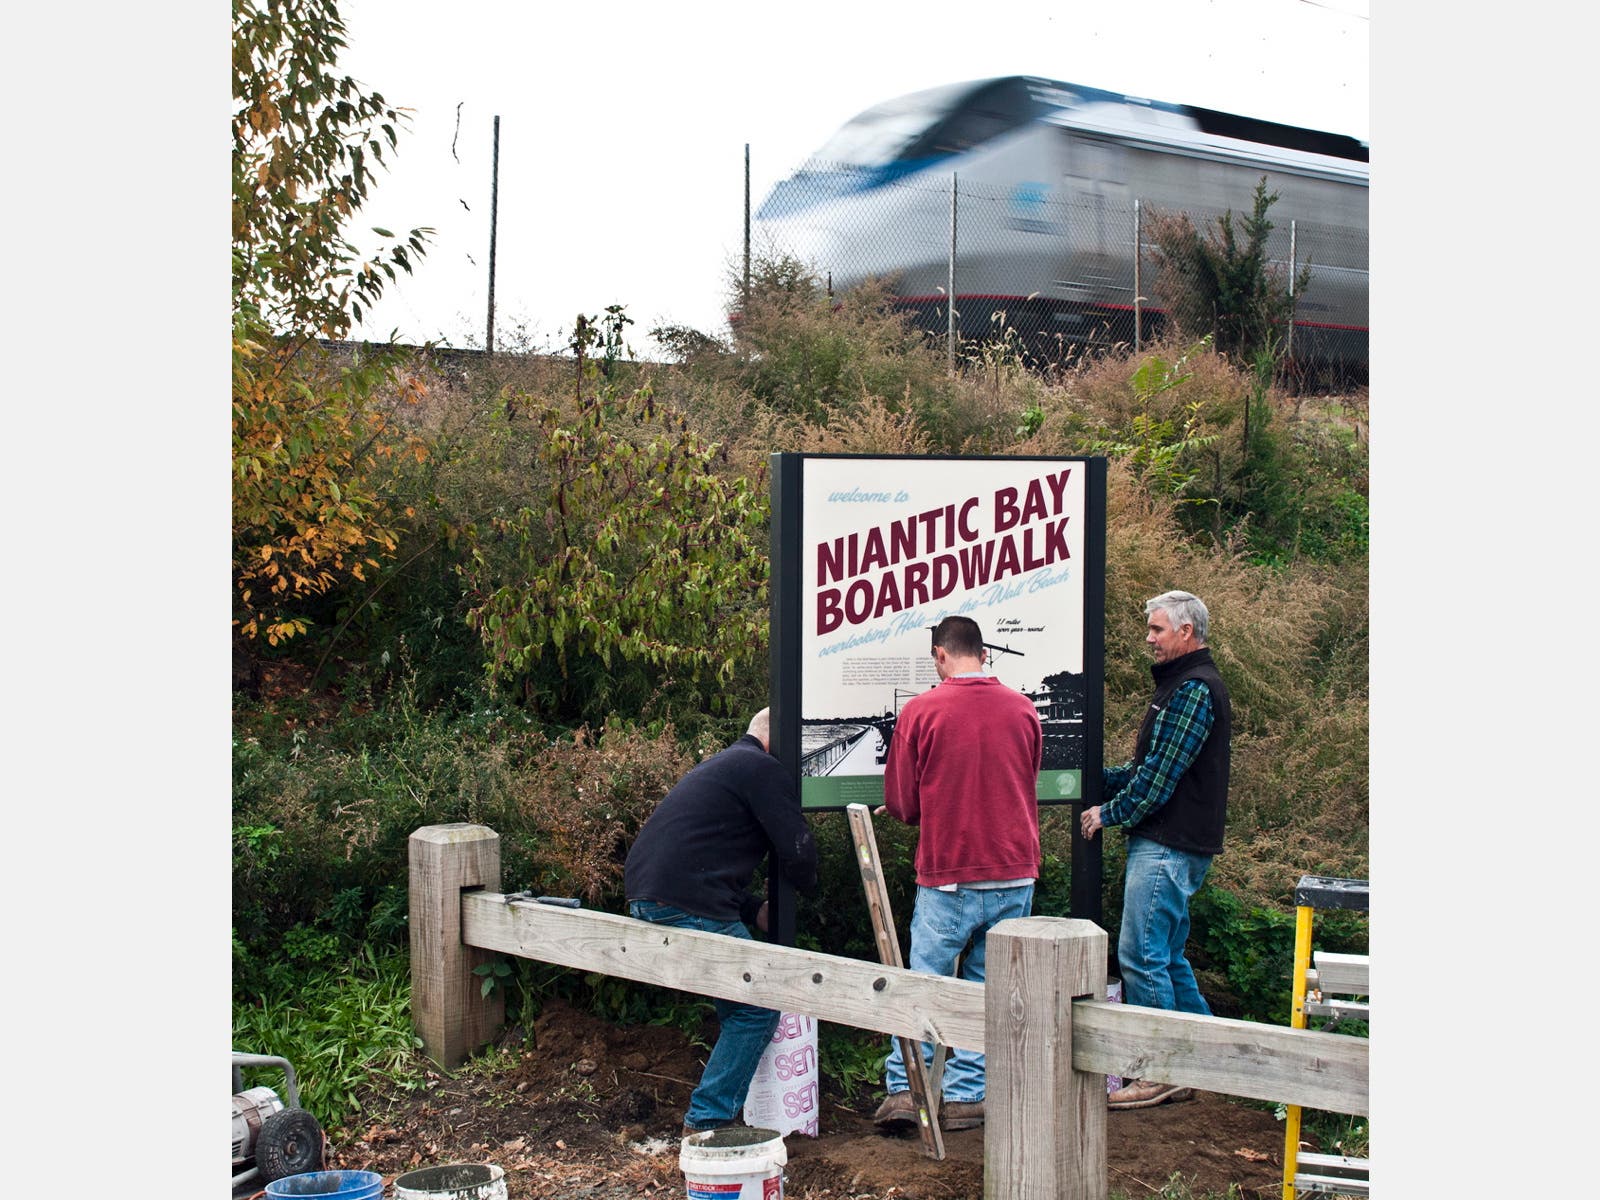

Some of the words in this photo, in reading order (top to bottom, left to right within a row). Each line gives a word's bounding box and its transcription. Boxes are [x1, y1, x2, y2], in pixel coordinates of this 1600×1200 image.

[816, 496, 979, 587] NIANTIC
[994, 468, 1072, 533] BAY
[827, 486, 892, 503] welcome
[893, 488, 910, 503] to
[816, 516, 1072, 636] BOARDWALK
[818, 626, 890, 657] overlooking
[1027, 567, 1071, 593] Beach
